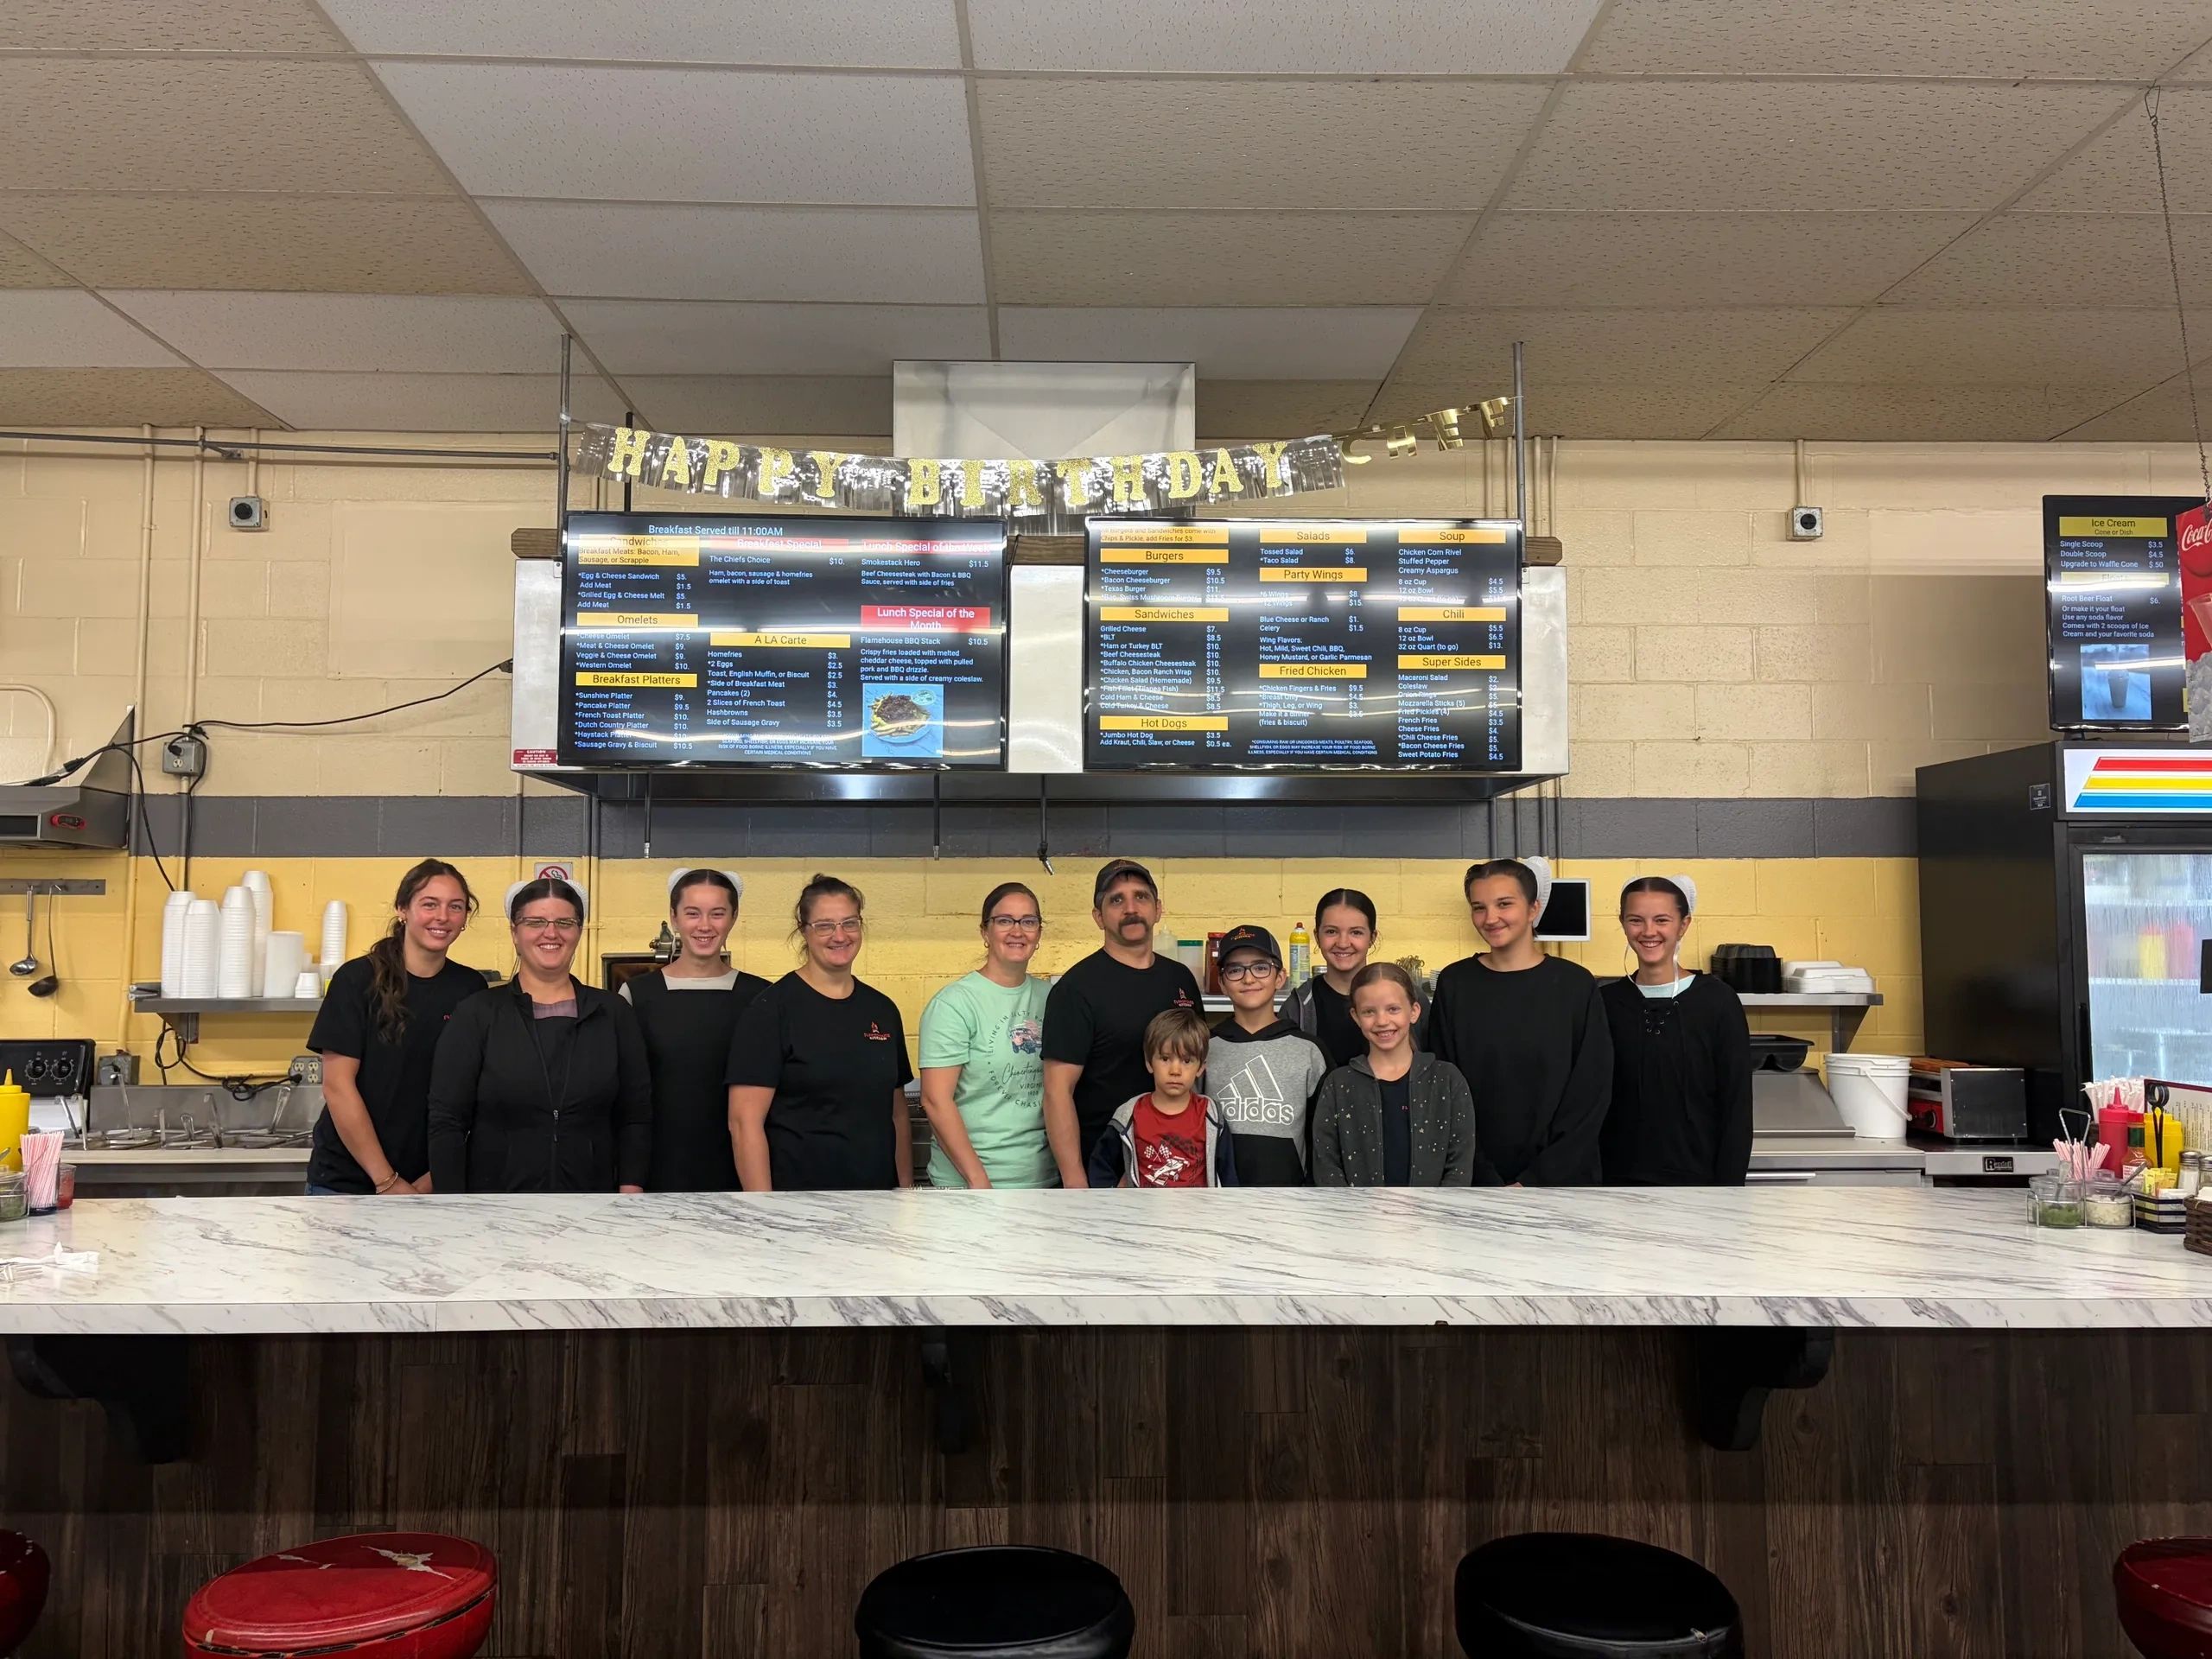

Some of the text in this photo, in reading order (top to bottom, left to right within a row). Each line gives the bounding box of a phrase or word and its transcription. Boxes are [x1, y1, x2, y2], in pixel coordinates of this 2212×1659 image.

[607, 427, 847, 499] HAPPY
[907, 442, 1287, 506] BIRTHDAY
[2091, 519, 2136, 527] Ice Cream
[648, 525, 783, 535] Breakfast Served till 11:00AM
[1296, 532, 1330, 540] Salads
[1439, 532, 1465, 543] Soup
[2060, 540, 2163, 549] Single Scoop $3.5
[1145, 551, 1184, 562] Burgers
[2085, 551, 2106, 559] Scoop
[2148, 550, 2163, 559] $4.5
[969, 559, 989, 568] $11.5
[2060, 561, 2089, 569] Upgrade
[1284, 570, 1343, 581] Party Wings
[1398, 567, 1425, 575] Creamy
[877, 608, 975, 620] Lunch Special of the
[1135, 609, 1195, 618] Sandwiches
[1443, 610, 1465, 619] Chili
[617, 615, 658, 624] Omelets
[910, 620, 942, 630] Month
[755, 636, 807, 644] A LA Carte
[968, 637, 988, 646] $10.5
[1259, 637, 1276, 645] Wing
[860, 649, 881, 657] Crispy
[914, 658, 937, 666] topped
[953, 658, 974, 667] pulled
[1259, 654, 1280, 662] Honey
[1422, 657, 1481, 668] Super Sides
[860, 666, 875, 674] pork
[1280, 666, 1347, 675] Fried Chicken
[593, 675, 680, 684] Breakfast Platters
[729, 671, 753, 679] English
[828, 671, 843, 680] $2.5
[740, 690, 750, 699] (2)
[827, 700, 842, 709] $4.5
[827, 710, 842, 718] $3.5
[1141, 719, 1187, 729] Hot Dogs
[1489, 752, 1503, 760] $4.5
[1220, 1096, 1294, 1125] didas
